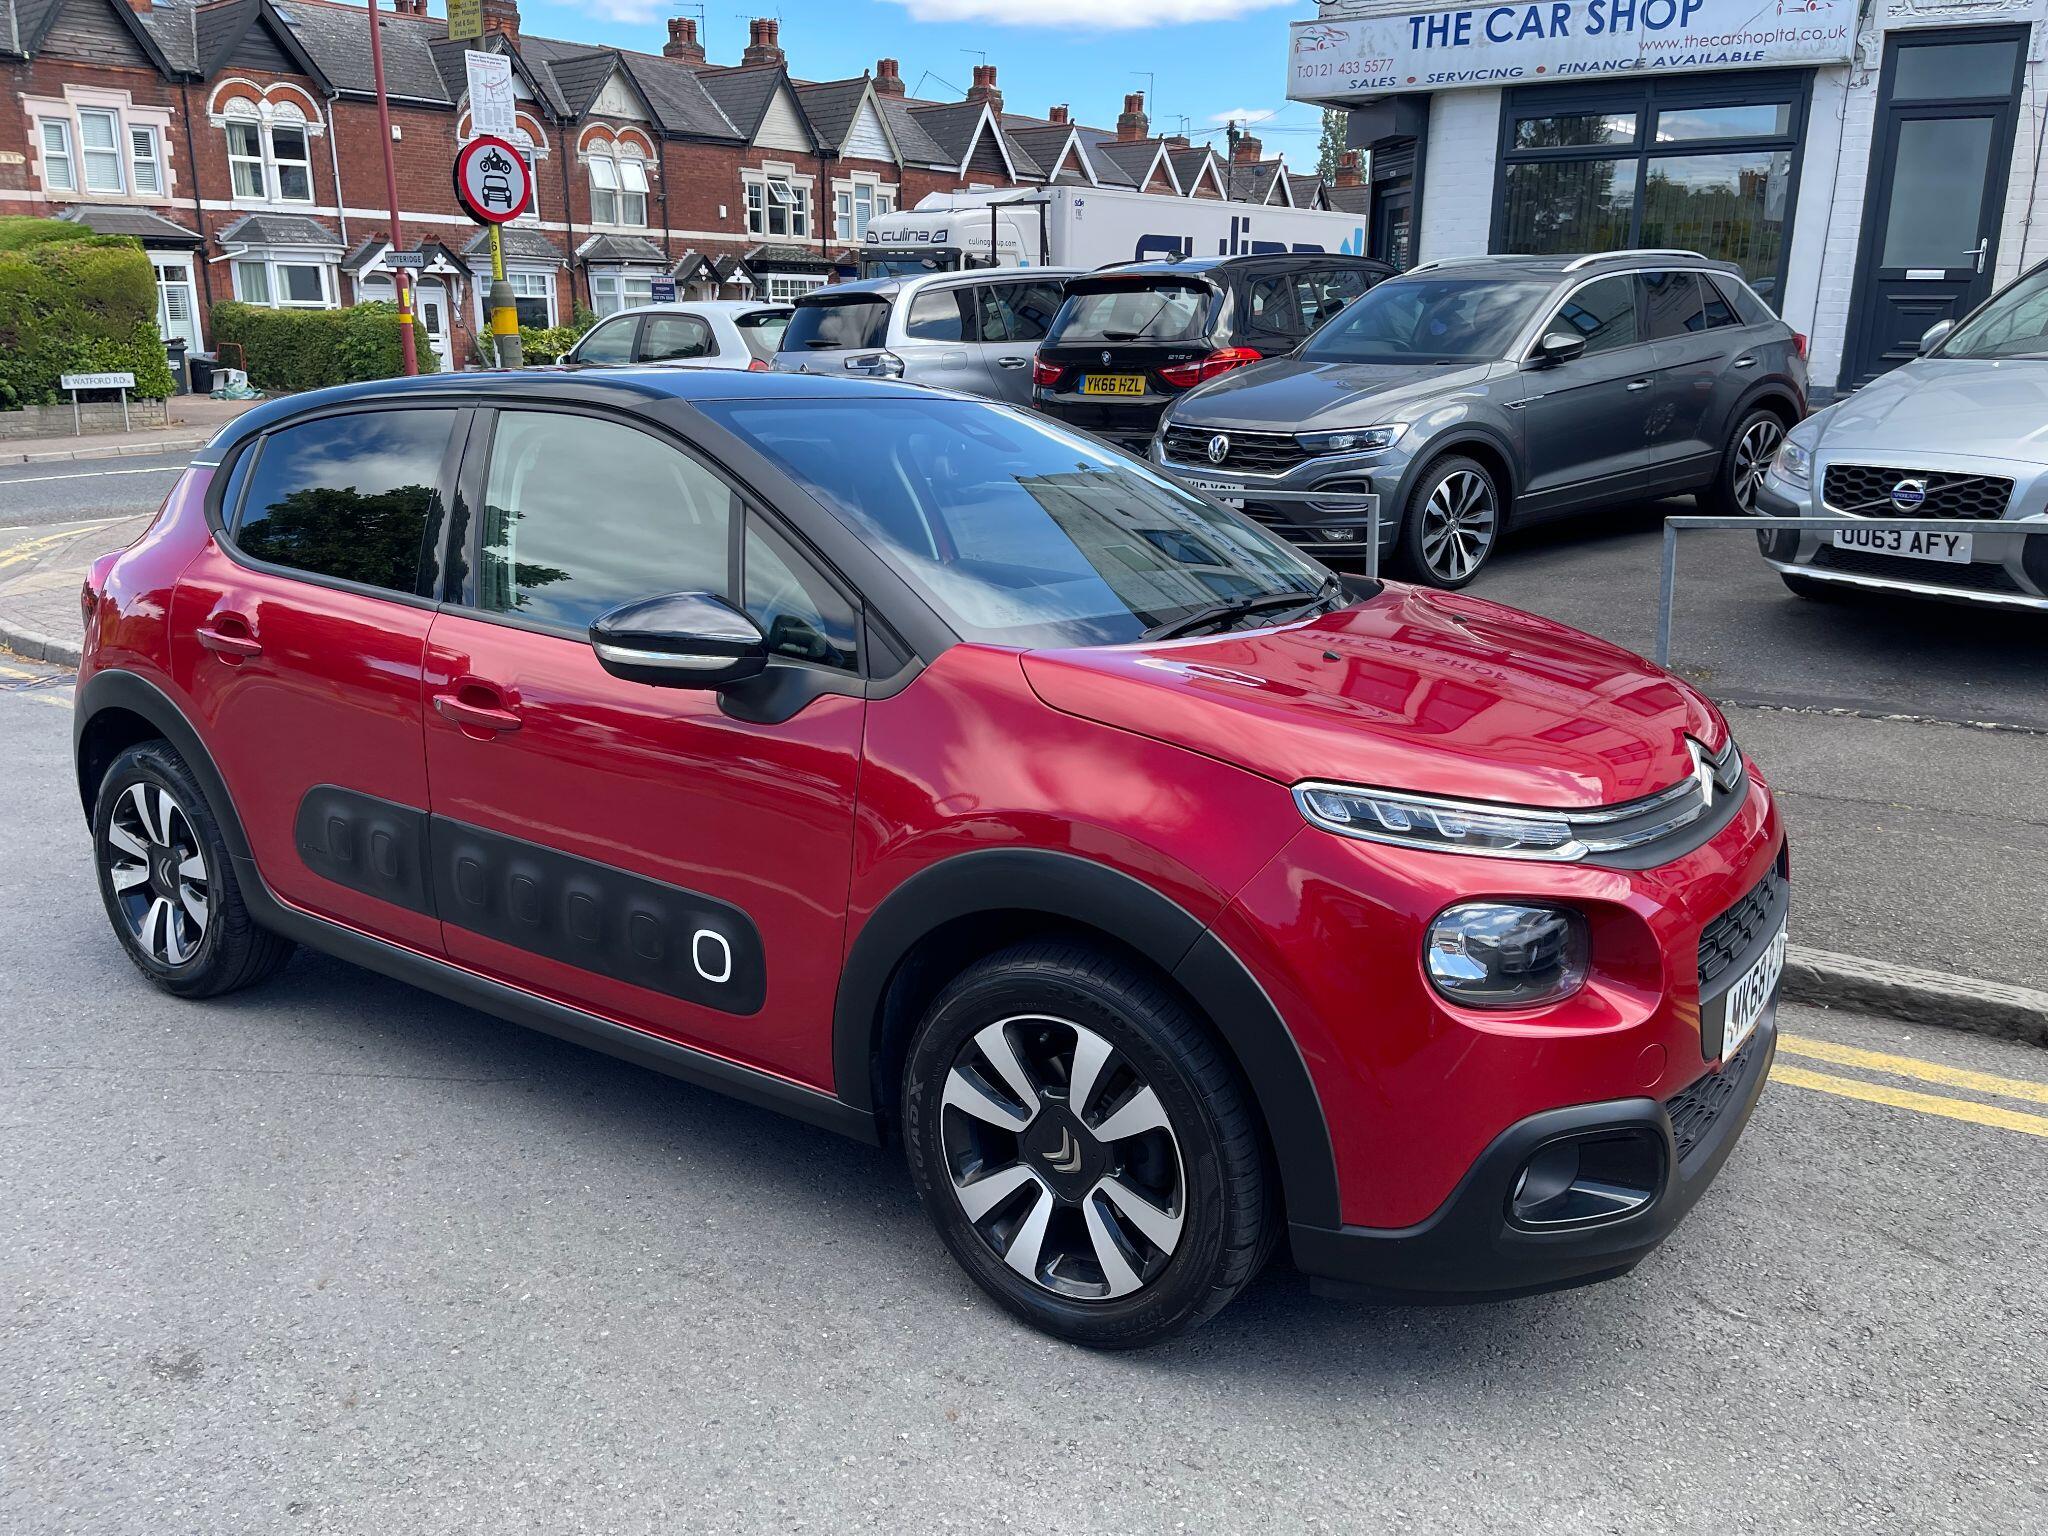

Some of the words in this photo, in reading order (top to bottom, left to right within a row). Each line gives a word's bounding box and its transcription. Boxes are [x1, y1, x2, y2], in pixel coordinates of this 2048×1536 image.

[1409, 11, 1473, 50] THE
[1485, 2, 1571, 43] CAR
[1585, 0, 1701, 36] SHOP
[1639, 24, 1848, 51] www.thecarshopltd.co.uk
[1338, 61, 1360, 75] 433
[1363, 58, 1394, 73] 5577
[1349, 76, 1397, 89] SALES
[1425, 66, 1524, 84] SERVICING
[1557, 57, 1647, 74] FINANCE
[1651, 50, 1766, 69] AVAILABLE
[881, 227, 930, 242] culina
[968, 237, 1017, 248] culinagup.com
[491, 241, 498, 252] 6
[72, 377, 111, 385] WATFORD
[1087, 376, 1116, 392] YK66
[1118, 376, 1142, 393] HZL
[1894, 492, 1922, 500] VOLVO
[1909, 531, 1960, 556] AFY
